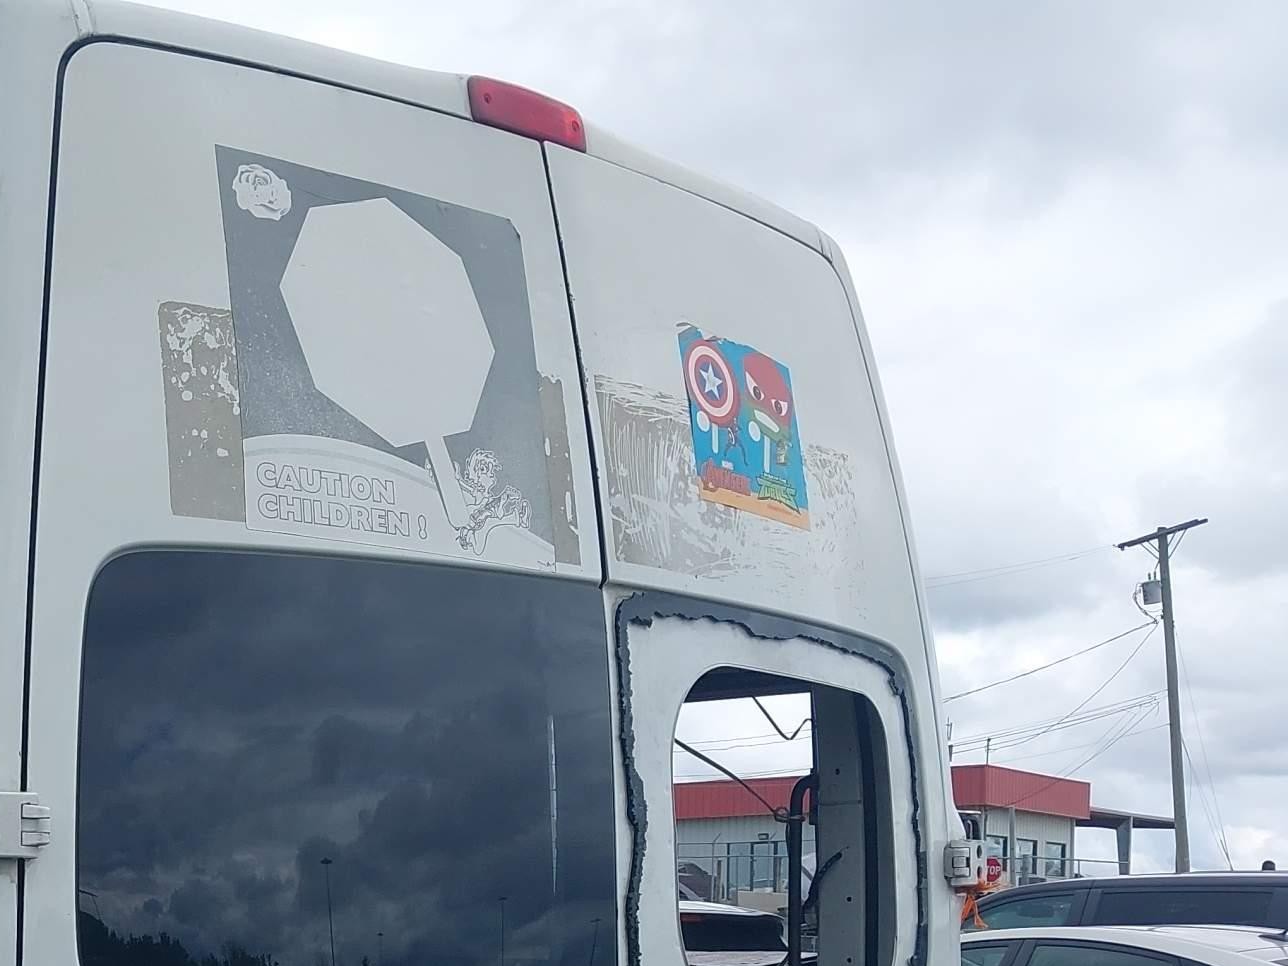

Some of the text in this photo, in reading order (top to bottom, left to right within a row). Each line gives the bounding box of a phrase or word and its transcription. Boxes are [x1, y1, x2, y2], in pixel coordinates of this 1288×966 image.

[256, 462, 396, 505] CAUTION
[257, 493, 428, 540] CHILDREN !
